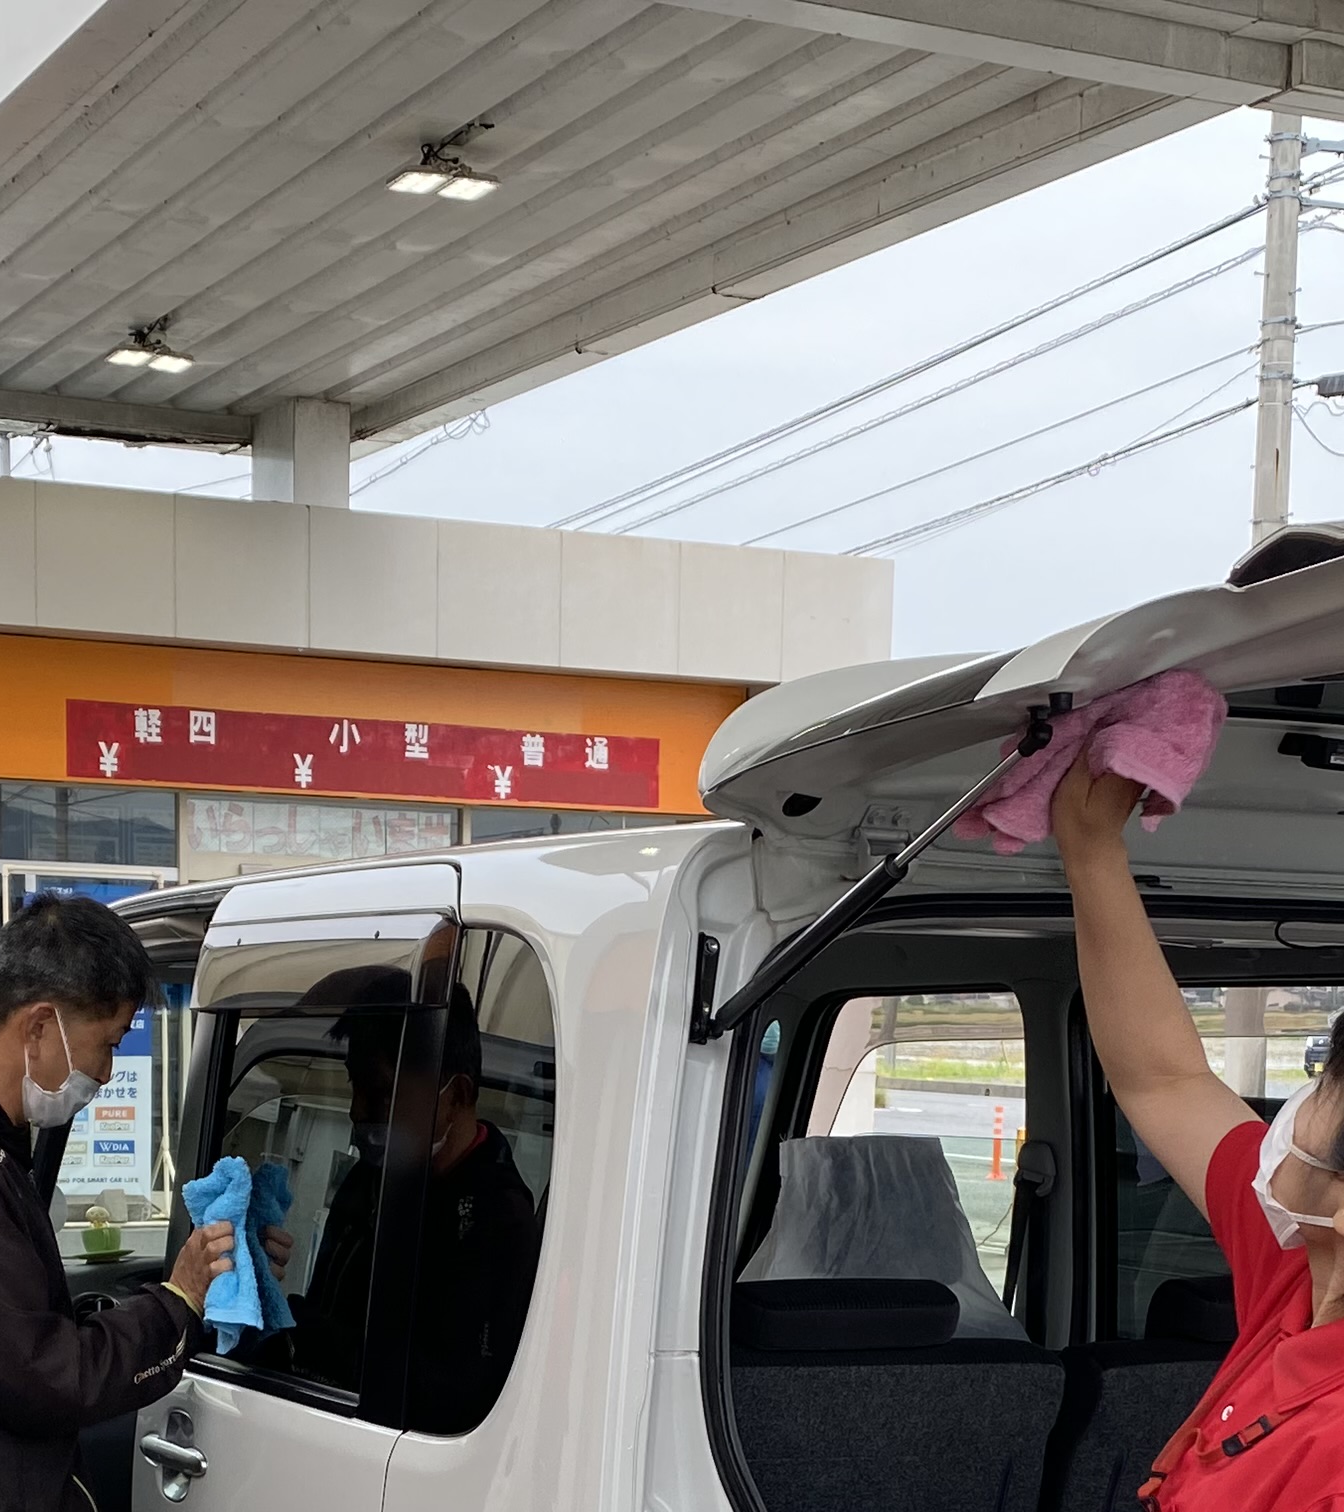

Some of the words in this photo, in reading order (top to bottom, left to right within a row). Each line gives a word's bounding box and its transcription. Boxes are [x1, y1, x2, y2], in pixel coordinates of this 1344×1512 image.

[98, 741, 120, 778] ¥
[293, 753, 314, 789] ¥
[493, 764, 514, 800] ¥
[101, 1109, 128, 1118] PURE
